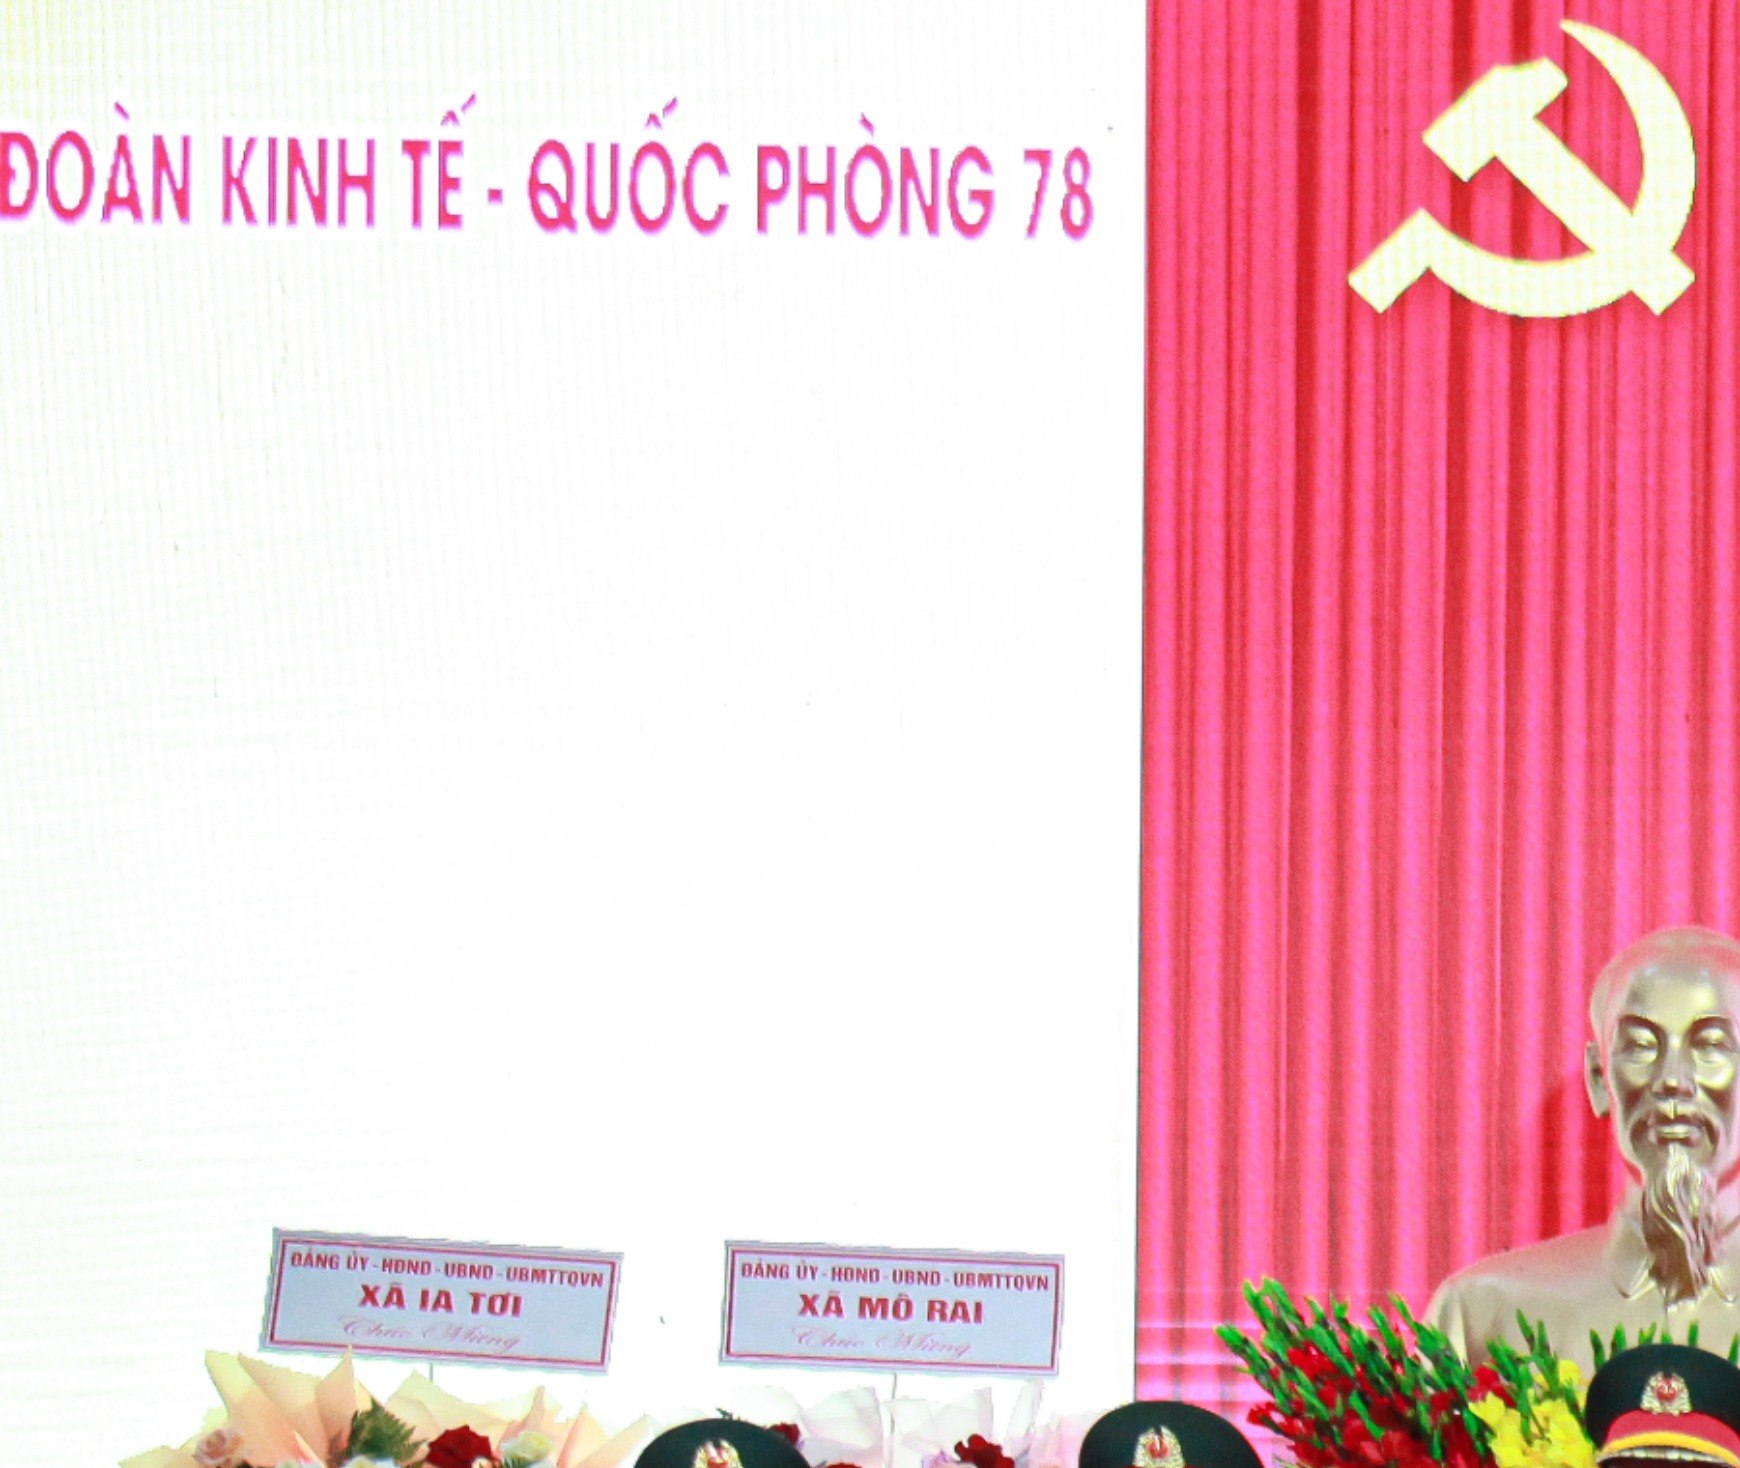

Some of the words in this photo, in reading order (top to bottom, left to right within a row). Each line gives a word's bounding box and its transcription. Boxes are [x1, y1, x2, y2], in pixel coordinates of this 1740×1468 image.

[0, 102, 191, 224] ĐOÀN
[223, 136, 375, 228] KINH
[402, 94, 476, 229] TẾ
[487, 188, 503, 203] -
[527, 97, 729, 236] QUỐC
[757, 114, 994, 239] PHÒNG
[1024, 147, 1093, 240] 78
[358, 1281, 407, 1312] XÃ
[419, 1288, 454, 1314] IA
[469, 1291, 523, 1318] TƠI
[798, 1290, 845, 1319] XÃ
[926, 1300, 984, 1324] RAI
